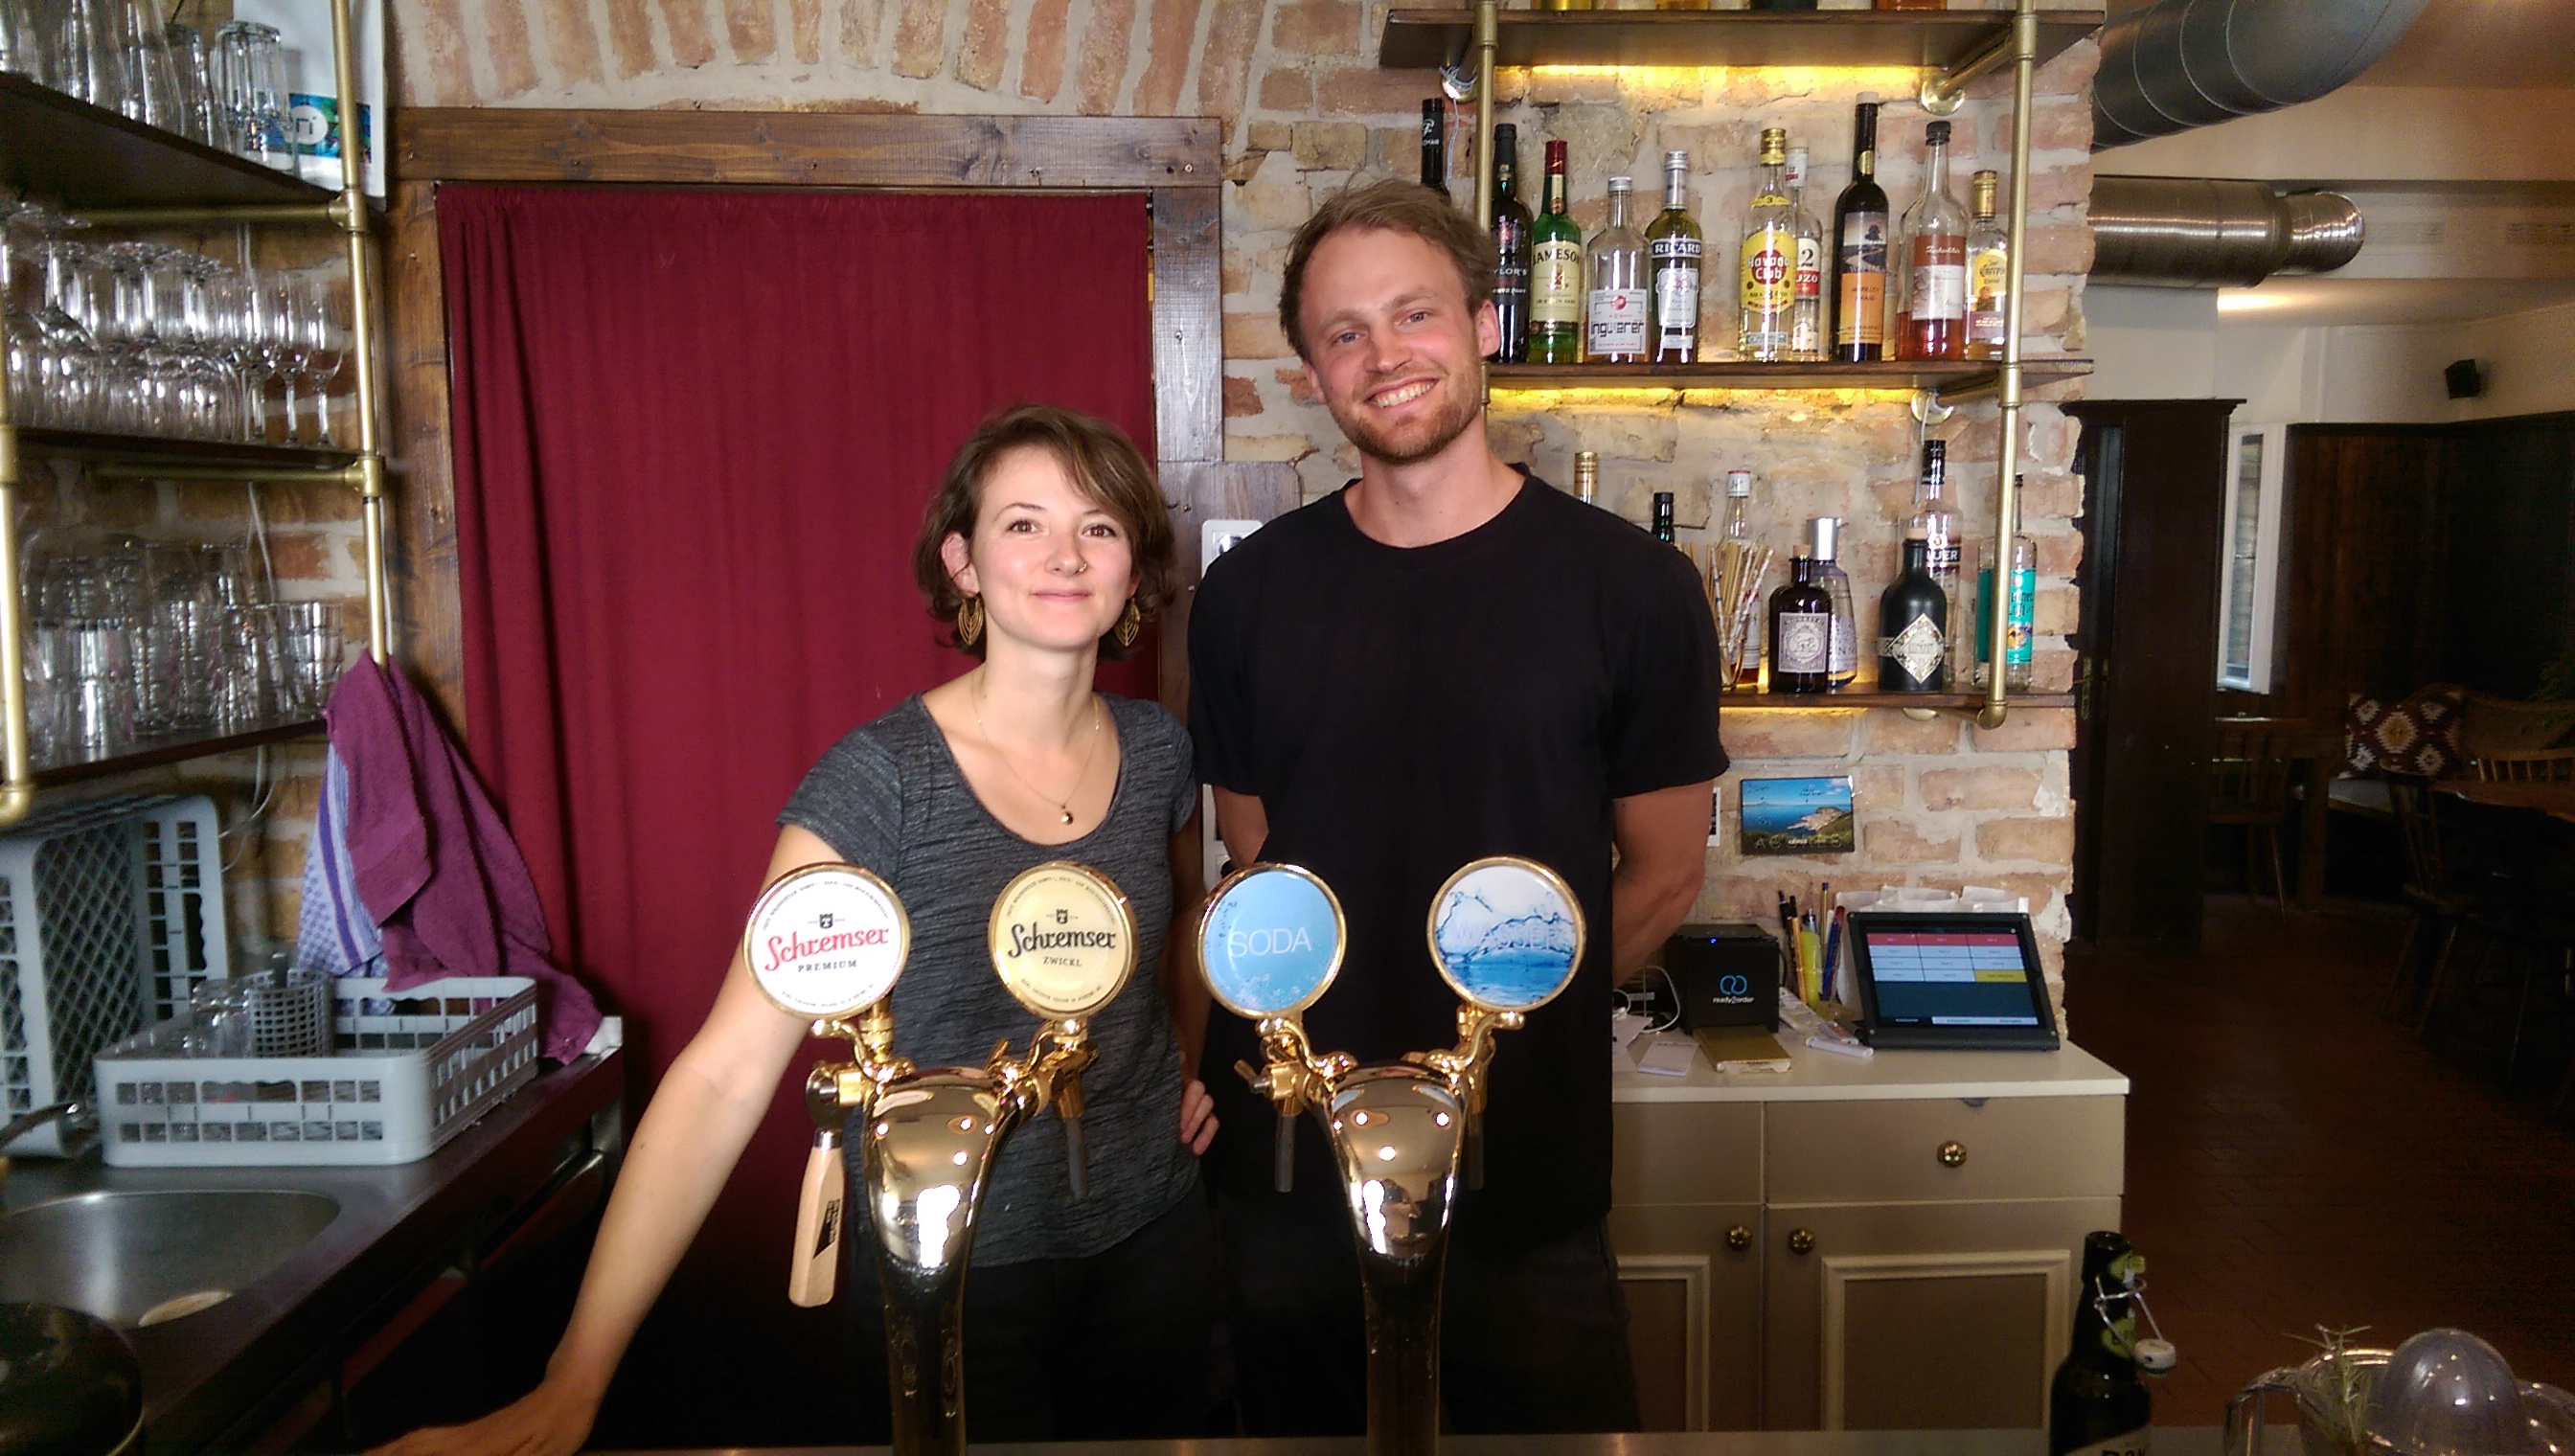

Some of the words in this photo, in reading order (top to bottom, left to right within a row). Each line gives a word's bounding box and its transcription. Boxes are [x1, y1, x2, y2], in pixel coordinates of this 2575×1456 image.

[1796, 274, 1818, 283] UZO
[1007, 921, 1116, 959] Schremser
[1228, 926, 1312, 958] SODA
[764, 927, 890, 972] Schremser
[797, 959, 857, 973] PREMIUM
[1042, 956, 1082, 967] ZWICKL
[1712, 996, 1755, 1005] ready2order
